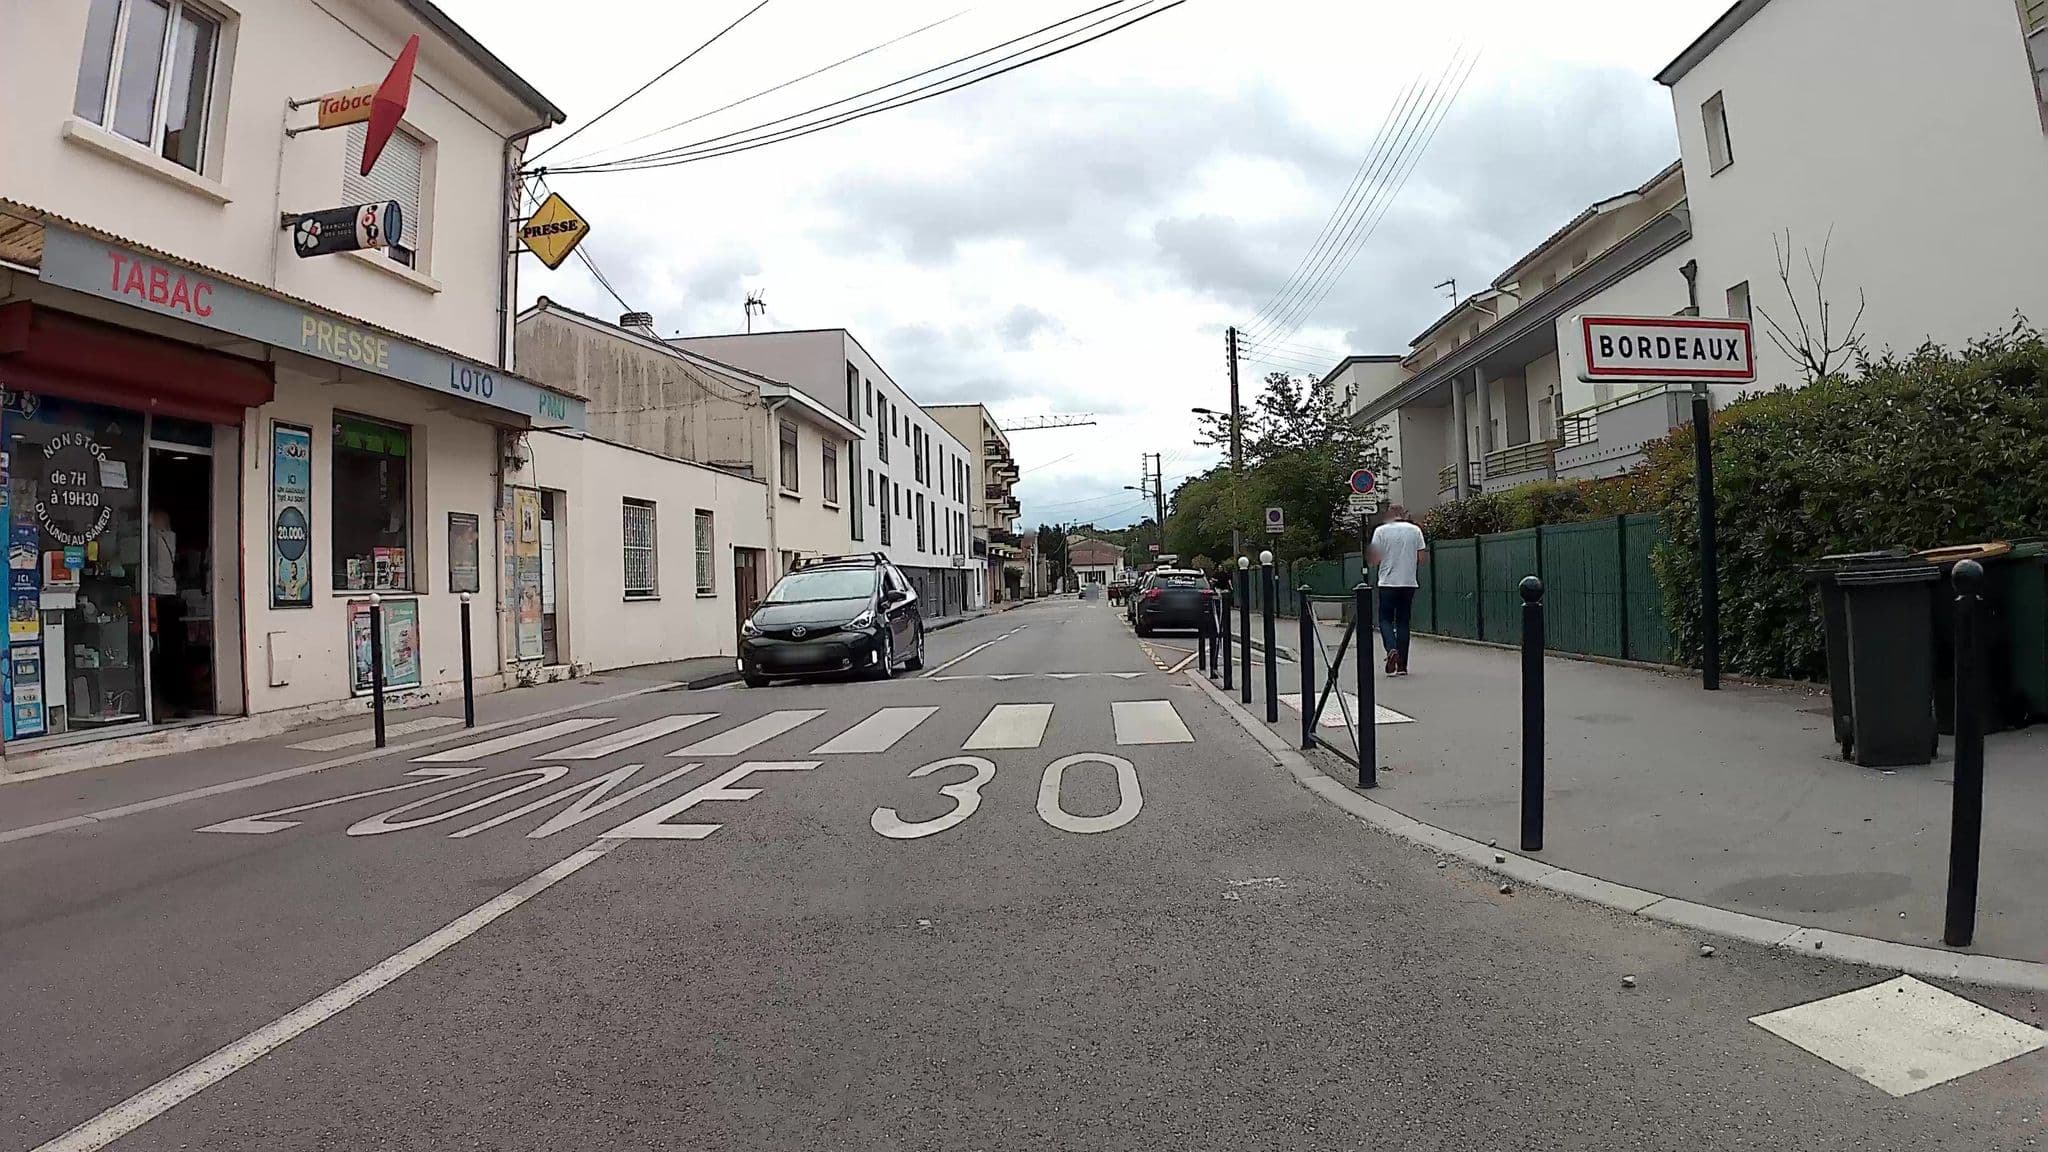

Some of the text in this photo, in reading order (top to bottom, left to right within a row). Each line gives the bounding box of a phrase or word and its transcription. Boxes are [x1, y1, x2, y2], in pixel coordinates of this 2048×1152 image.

[321, 95, 371, 115] Tabac
[523, 219, 578, 239] PRESSE
[108, 250, 567, 420] TABAC PRESSE LOTO PMU
[1599, 335, 1740, 361] BORDEAUX
[43, 433, 106, 462] NON STOP
[51, 470, 86, 486] de 7H
[50, 489, 99, 507] à 19H30
[35, 502, 112, 546] DU LUNDI AU SAMEDI
[17, 574, 29, 583] ICI
[193, 753, 1144, 840] ZONE 30
